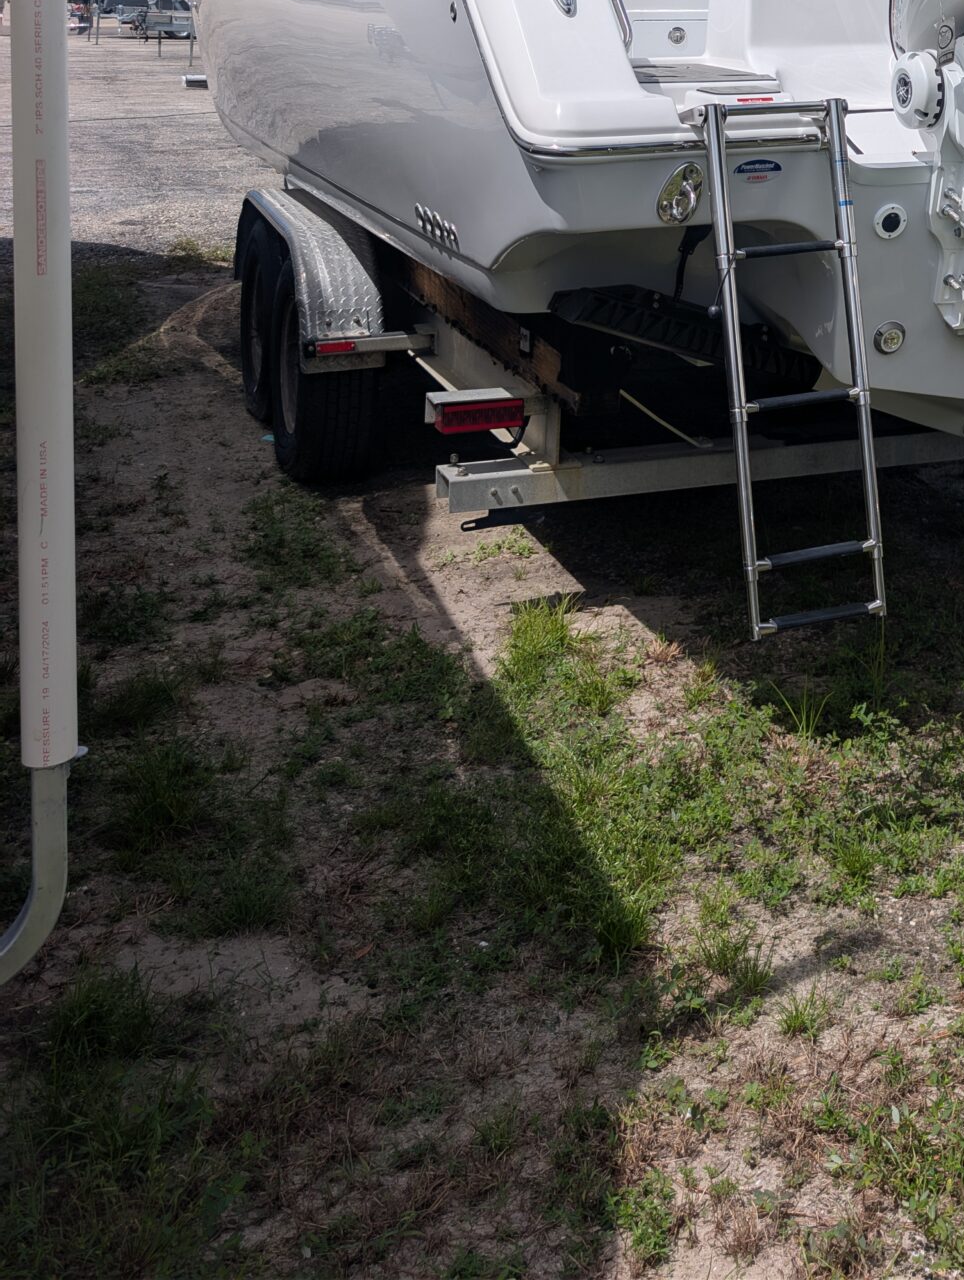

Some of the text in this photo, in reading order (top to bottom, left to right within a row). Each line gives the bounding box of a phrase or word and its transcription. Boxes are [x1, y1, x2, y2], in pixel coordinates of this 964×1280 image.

[33, 11, 43, 54] SERIES
[34, 57, 43, 71] 40
[34, 73, 44, 98] SCH
[34, 101, 44, 121] IPS
[36, 160, 46, 276] SANDERSON PIPE
[39, 440, 48, 518] MADE IN USA
[40, 541, 48, 550] C
[41, 620, 50, 680] 04/17/2024
[42, 687, 50, 700] 19
[42, 708, 51, 768] PRESSURE
